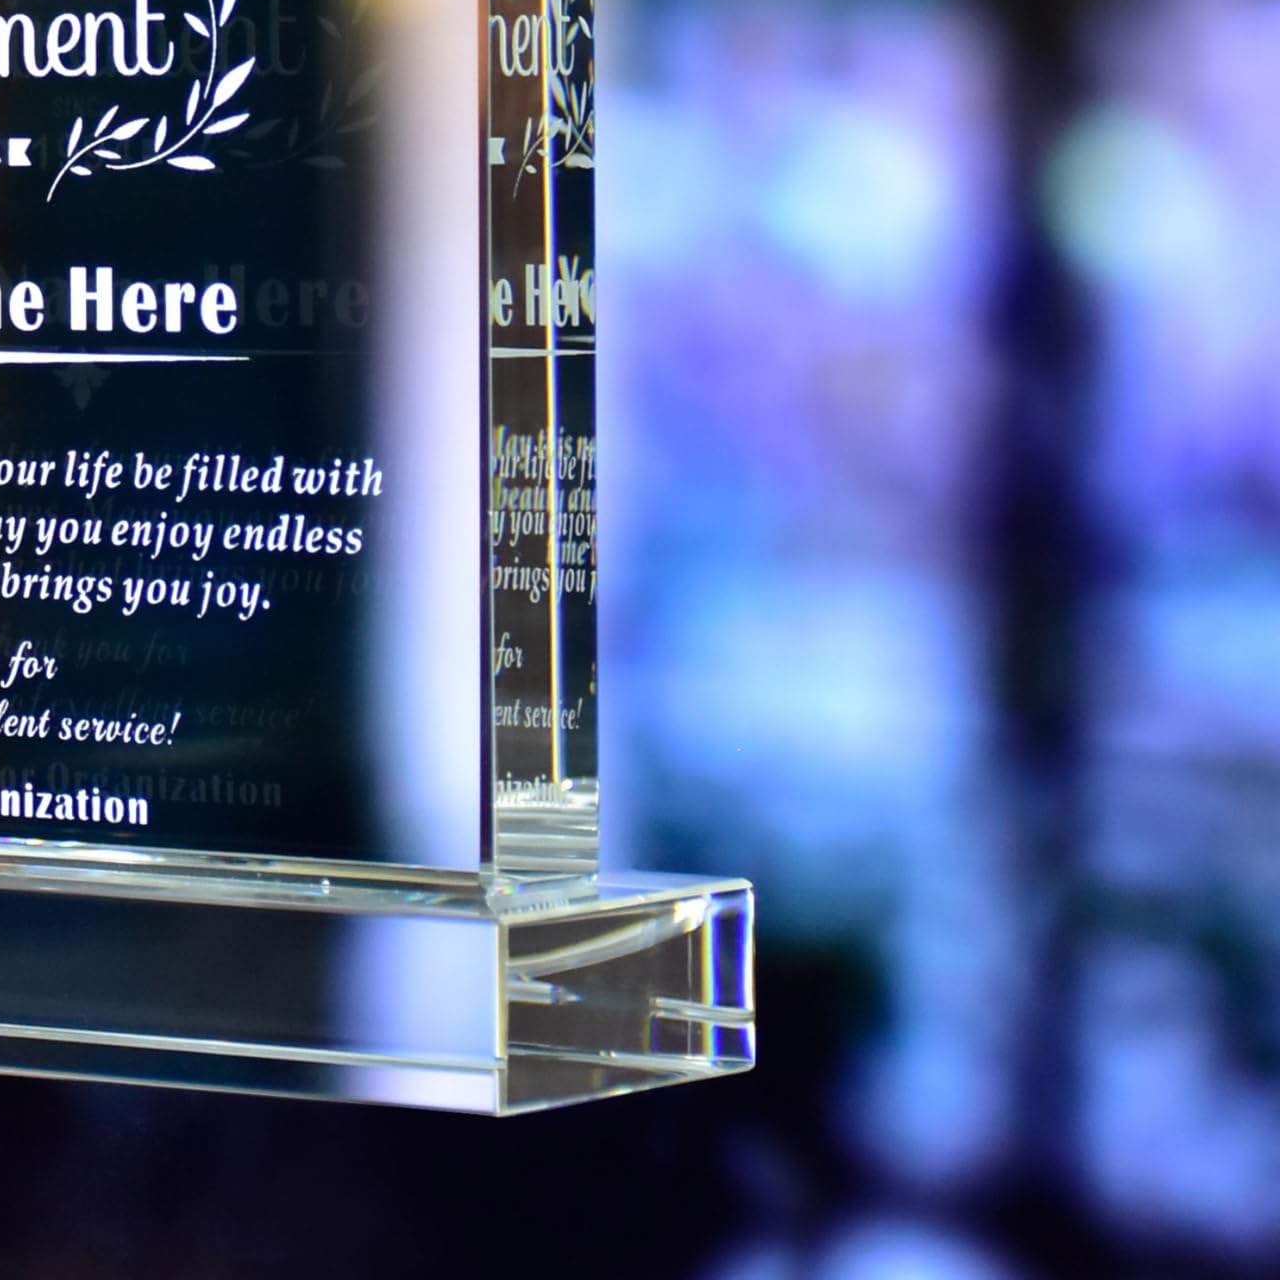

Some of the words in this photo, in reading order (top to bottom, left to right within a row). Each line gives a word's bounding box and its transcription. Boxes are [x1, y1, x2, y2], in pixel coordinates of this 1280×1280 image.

[69, 266, 238, 335] Here
[64, 450, 124, 500] life
[133, 451, 173, 490] be
[175, 452, 285, 503] filled
[292, 457, 384, 497] with
[35, 517, 103, 556] you
[111, 511, 214, 562] enjoy
[223, 513, 363, 555] endless
[1, 561, 113, 614] brings
[122, 577, 191, 617] you
[196, 570, 271, 621] joy.
[0, 640, 56, 689] for
[58, 712, 182, 745] service!
